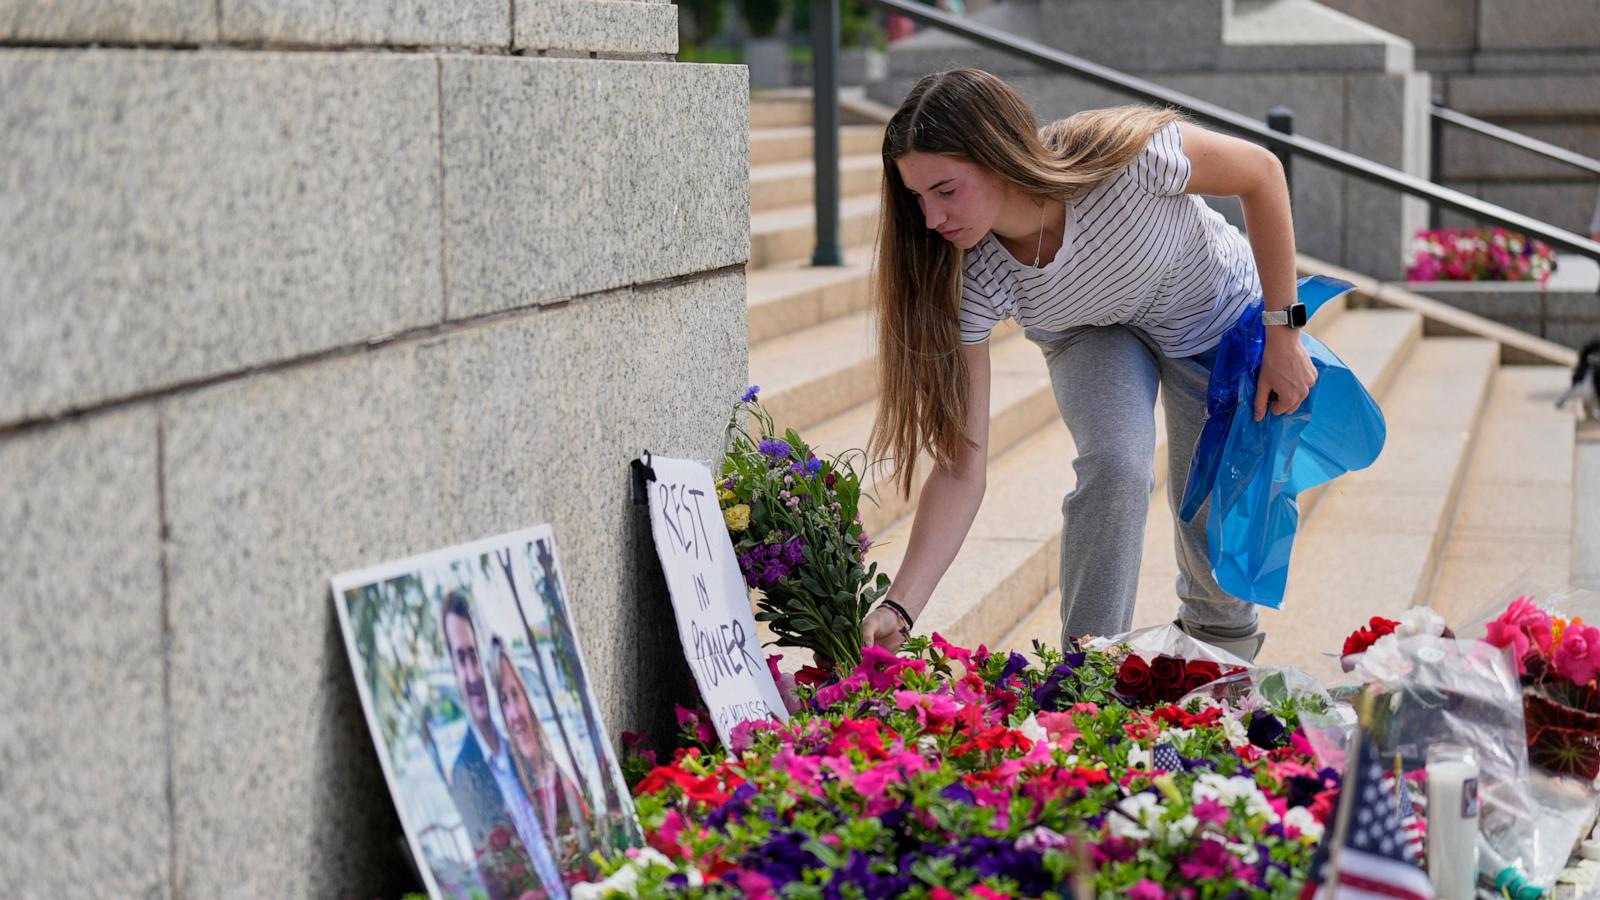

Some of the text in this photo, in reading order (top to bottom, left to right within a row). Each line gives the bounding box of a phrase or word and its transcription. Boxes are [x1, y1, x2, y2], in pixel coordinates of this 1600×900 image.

[659, 483, 713, 562] REST
[692, 573, 710, 612] IN
[691, 619, 762, 691] POWER
